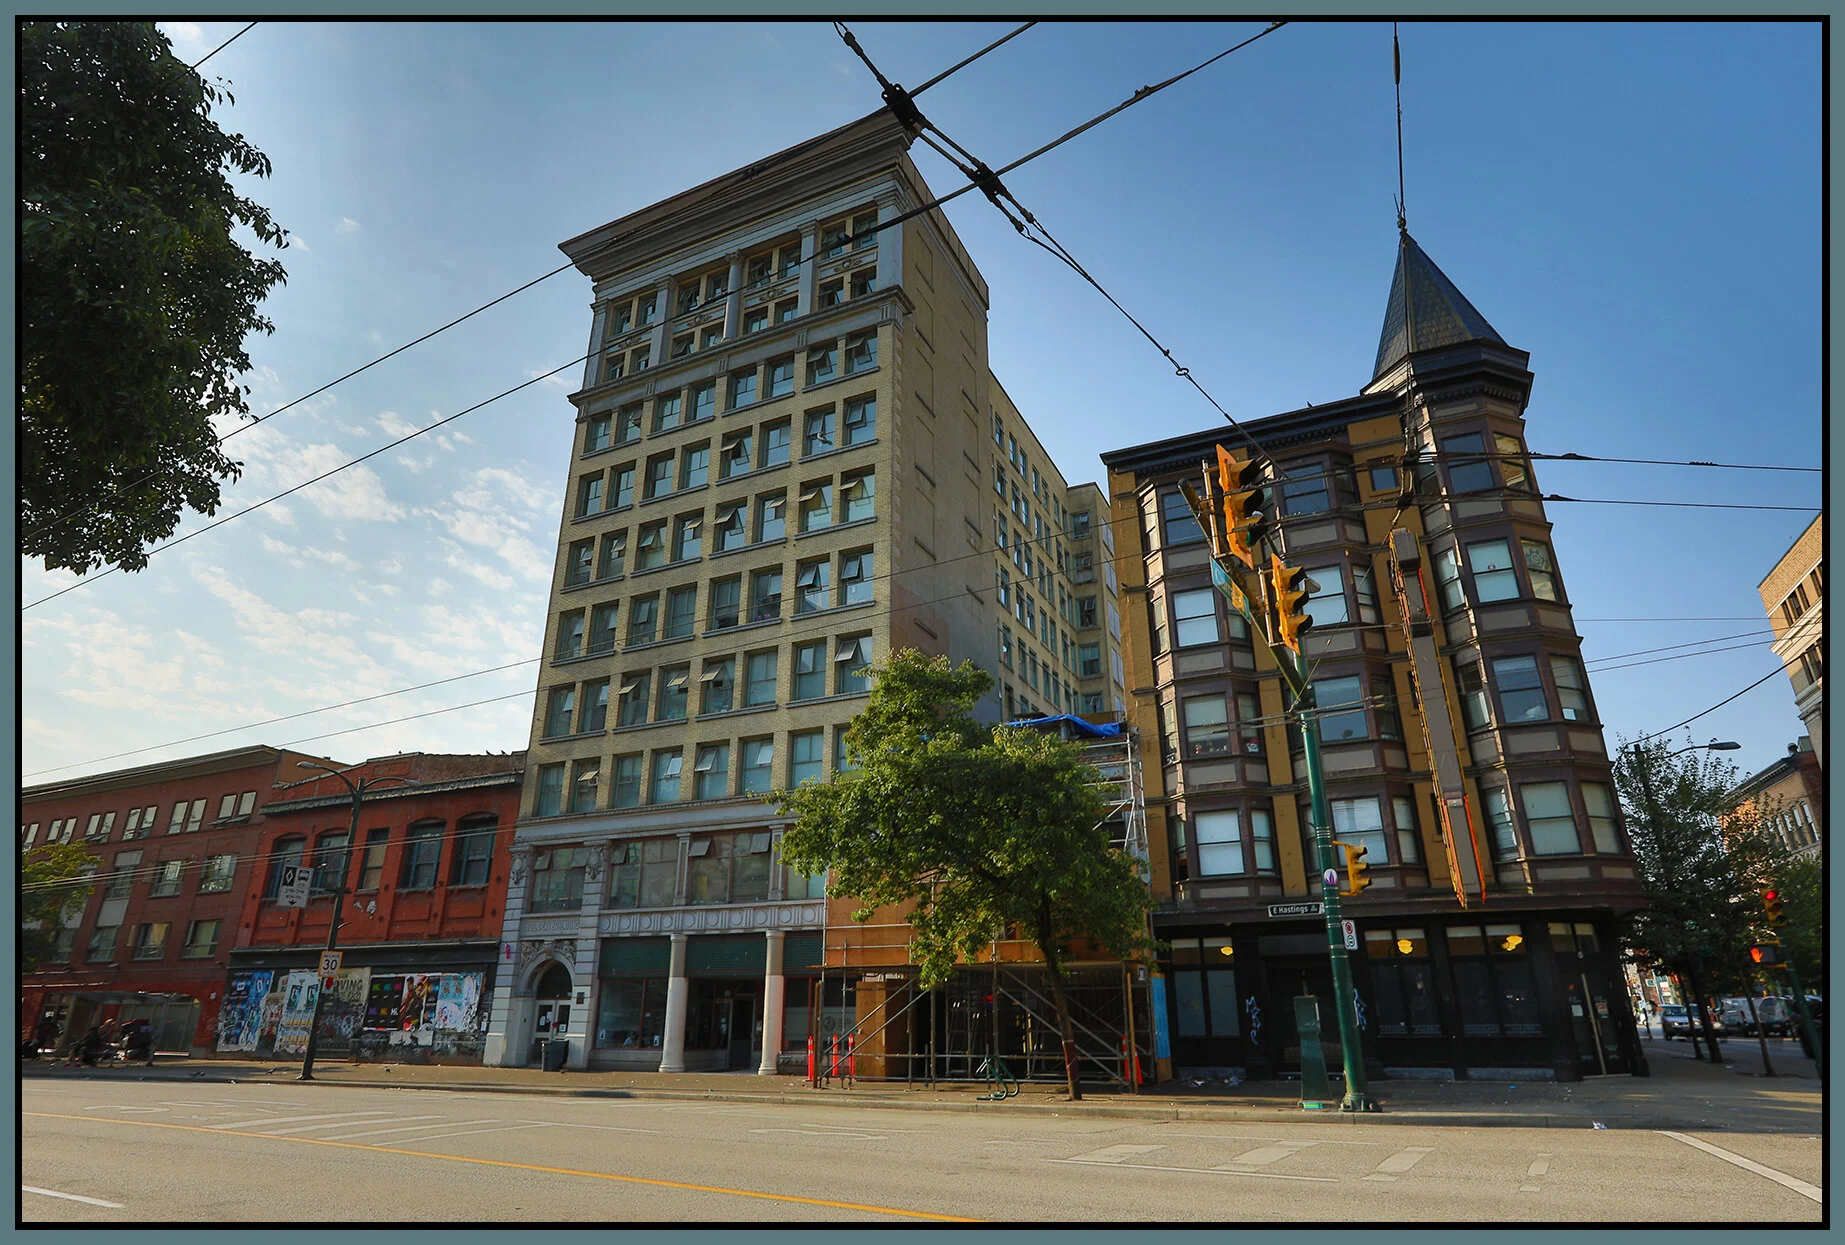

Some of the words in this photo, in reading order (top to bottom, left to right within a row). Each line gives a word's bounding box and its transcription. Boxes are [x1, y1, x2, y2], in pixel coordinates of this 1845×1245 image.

[1279, 905, 1309, 915] Hastings
[322, 958, 338, 971] 30
[334, 979, 363, 991] OVING
